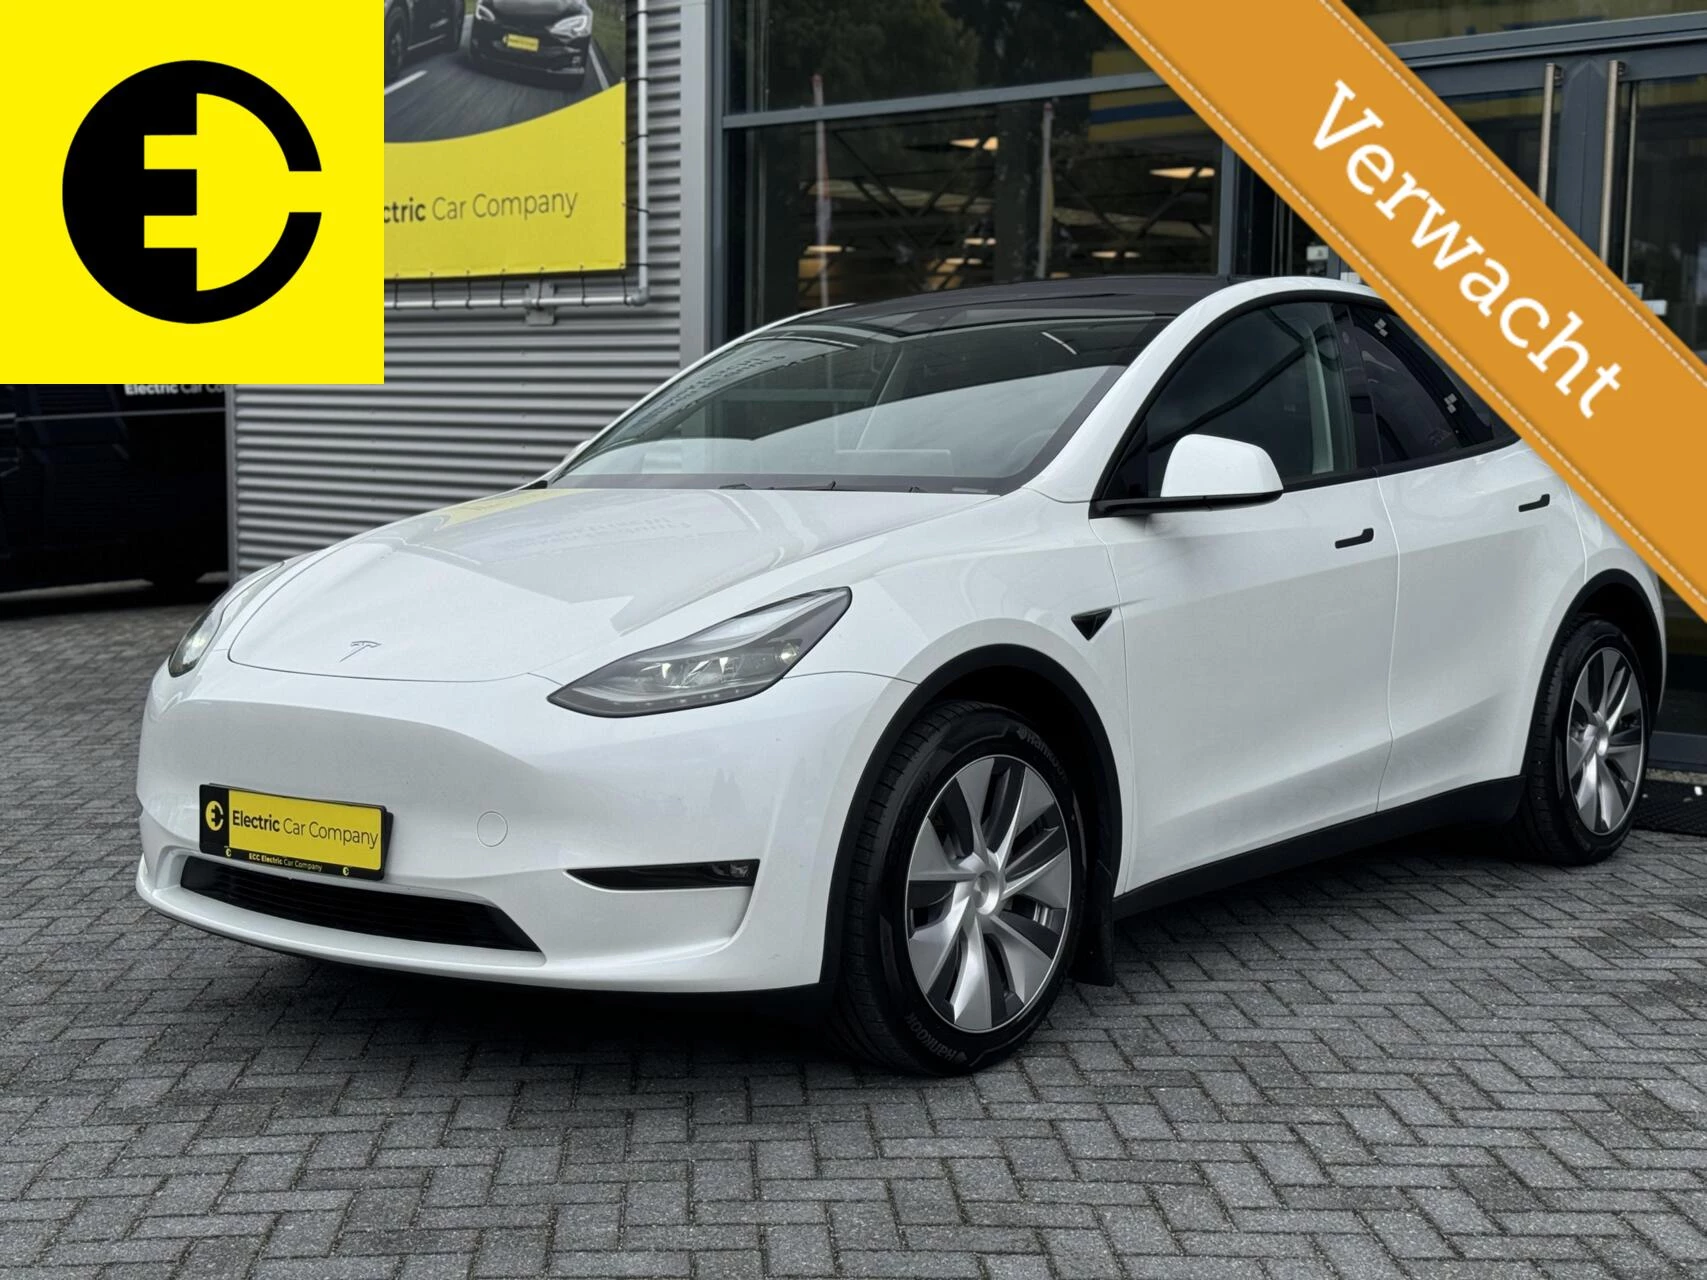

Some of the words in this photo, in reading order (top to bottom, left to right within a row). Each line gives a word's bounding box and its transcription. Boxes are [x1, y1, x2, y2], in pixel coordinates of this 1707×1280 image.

[384, 197, 426, 224] ctric
[432, 197, 467, 221] Car
[472, 192, 578, 220] Company
[232, 809, 280, 832] Electric
[283, 817, 305, 836] Car
[309, 821, 379, 849] Company
[248, 853, 260, 861] ECC
[261, 855, 283, 865] Electric
[284, 859, 293, 867] Car
[295, 861, 322, 872] Company
